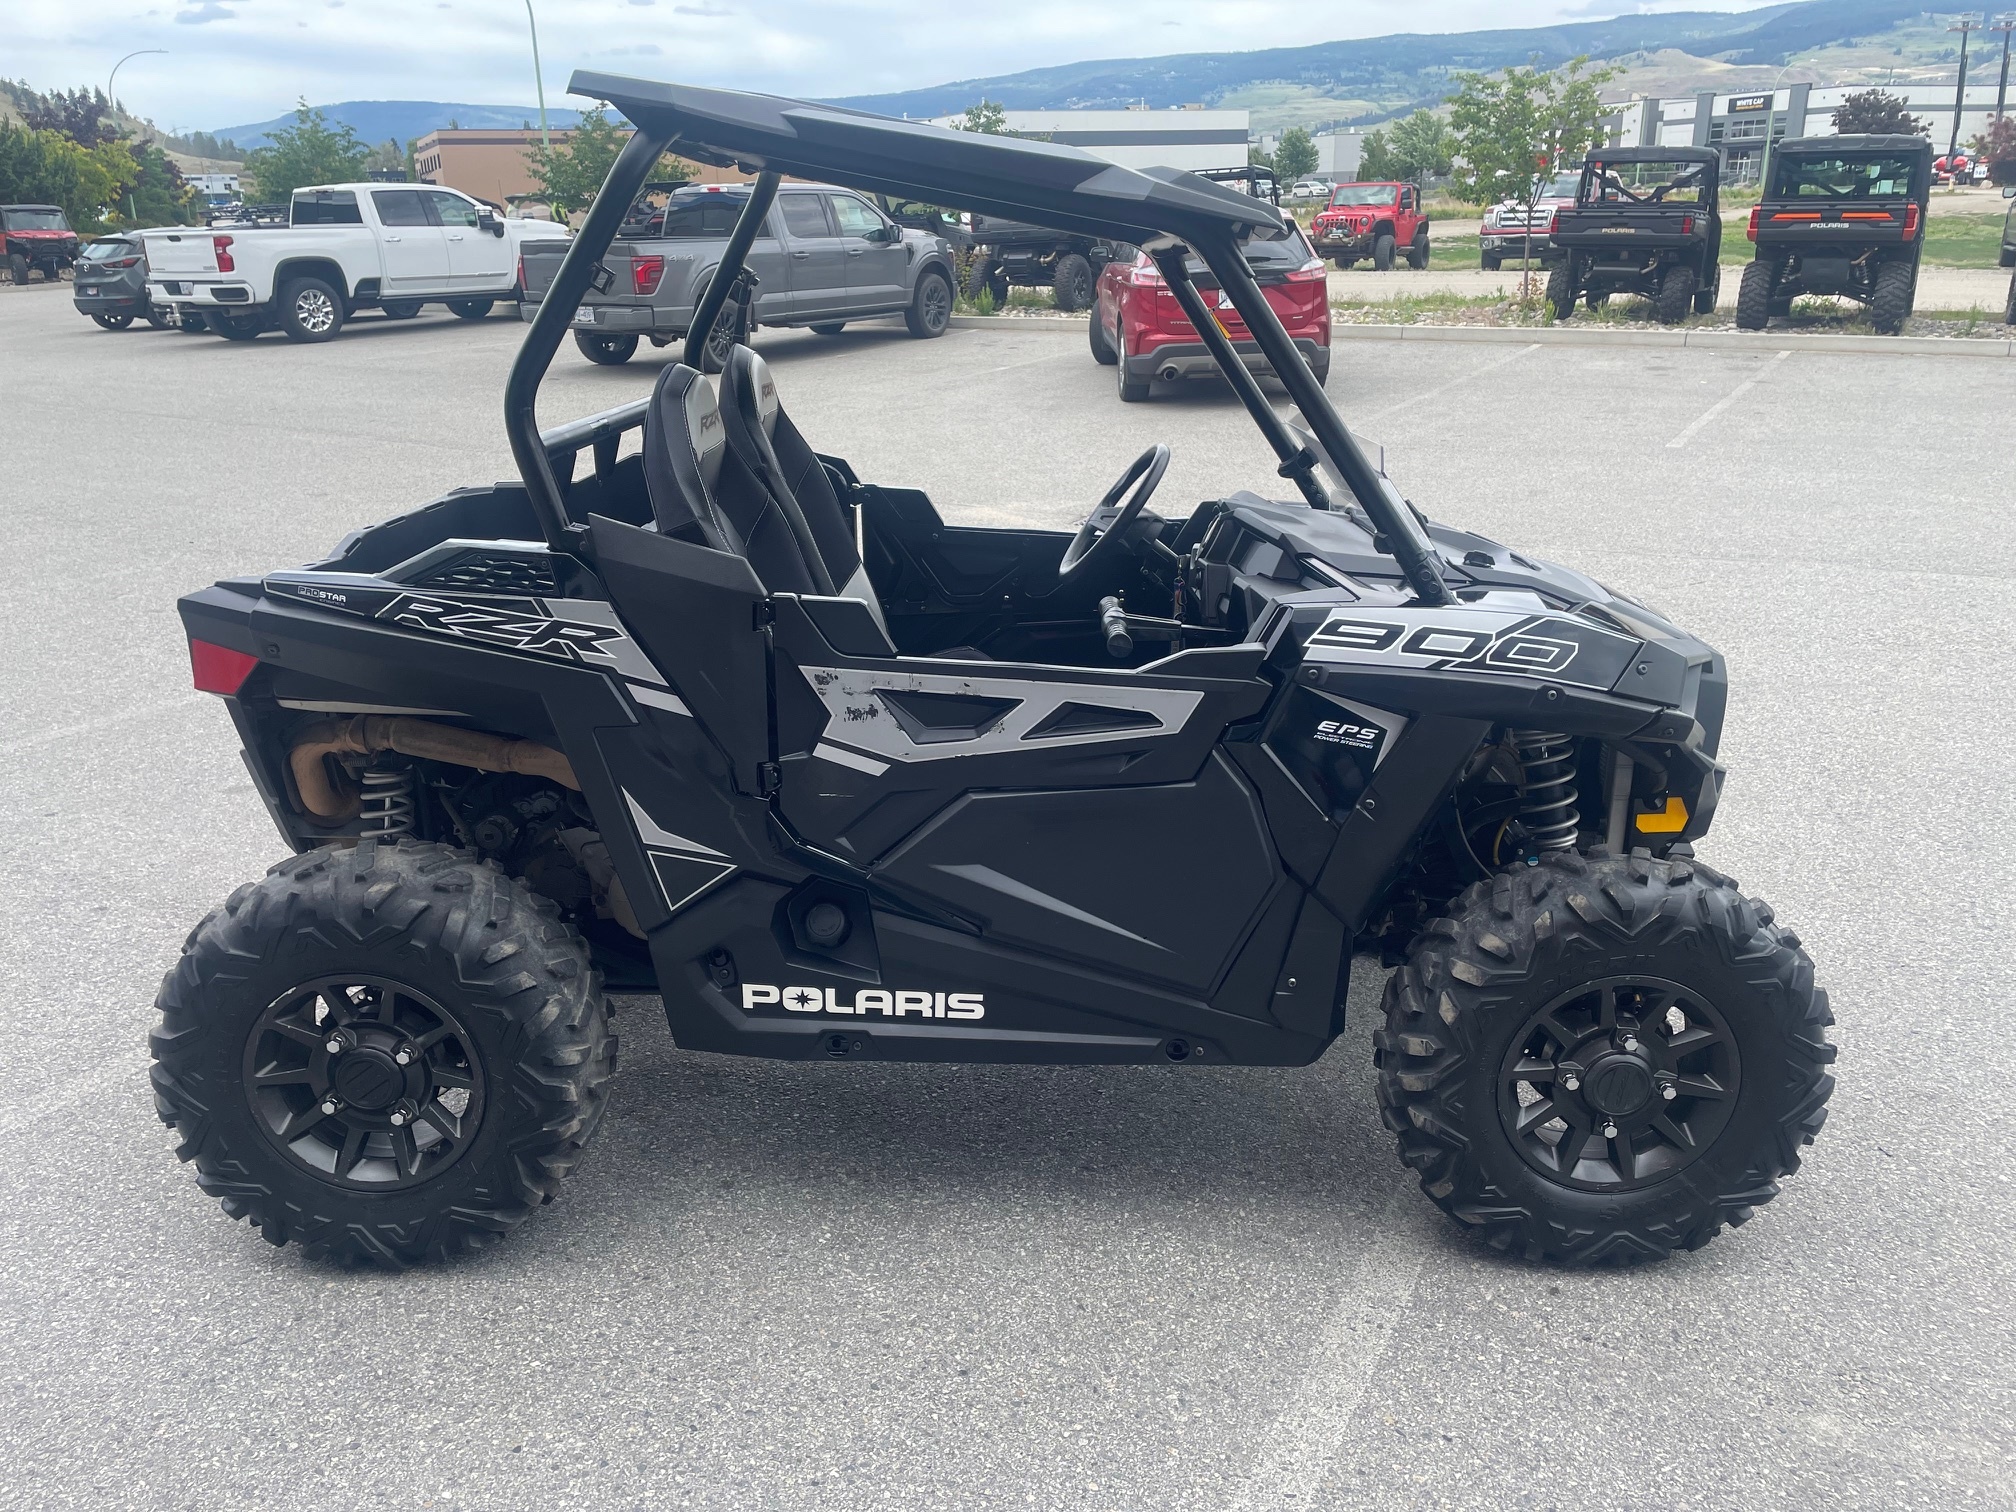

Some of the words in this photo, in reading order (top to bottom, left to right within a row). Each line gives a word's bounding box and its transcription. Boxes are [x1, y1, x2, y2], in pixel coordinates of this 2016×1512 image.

[298, 586, 347, 603] PROSTAR
[385, 592, 628, 659] RZR
[1302, 617, 1580, 673] 900
[1313, 734, 1340, 743] POWER
[1340, 739, 1374, 750] STEERING
[1317, 720, 1379, 740] EPS
[742, 983, 985, 1020] POLARIS
